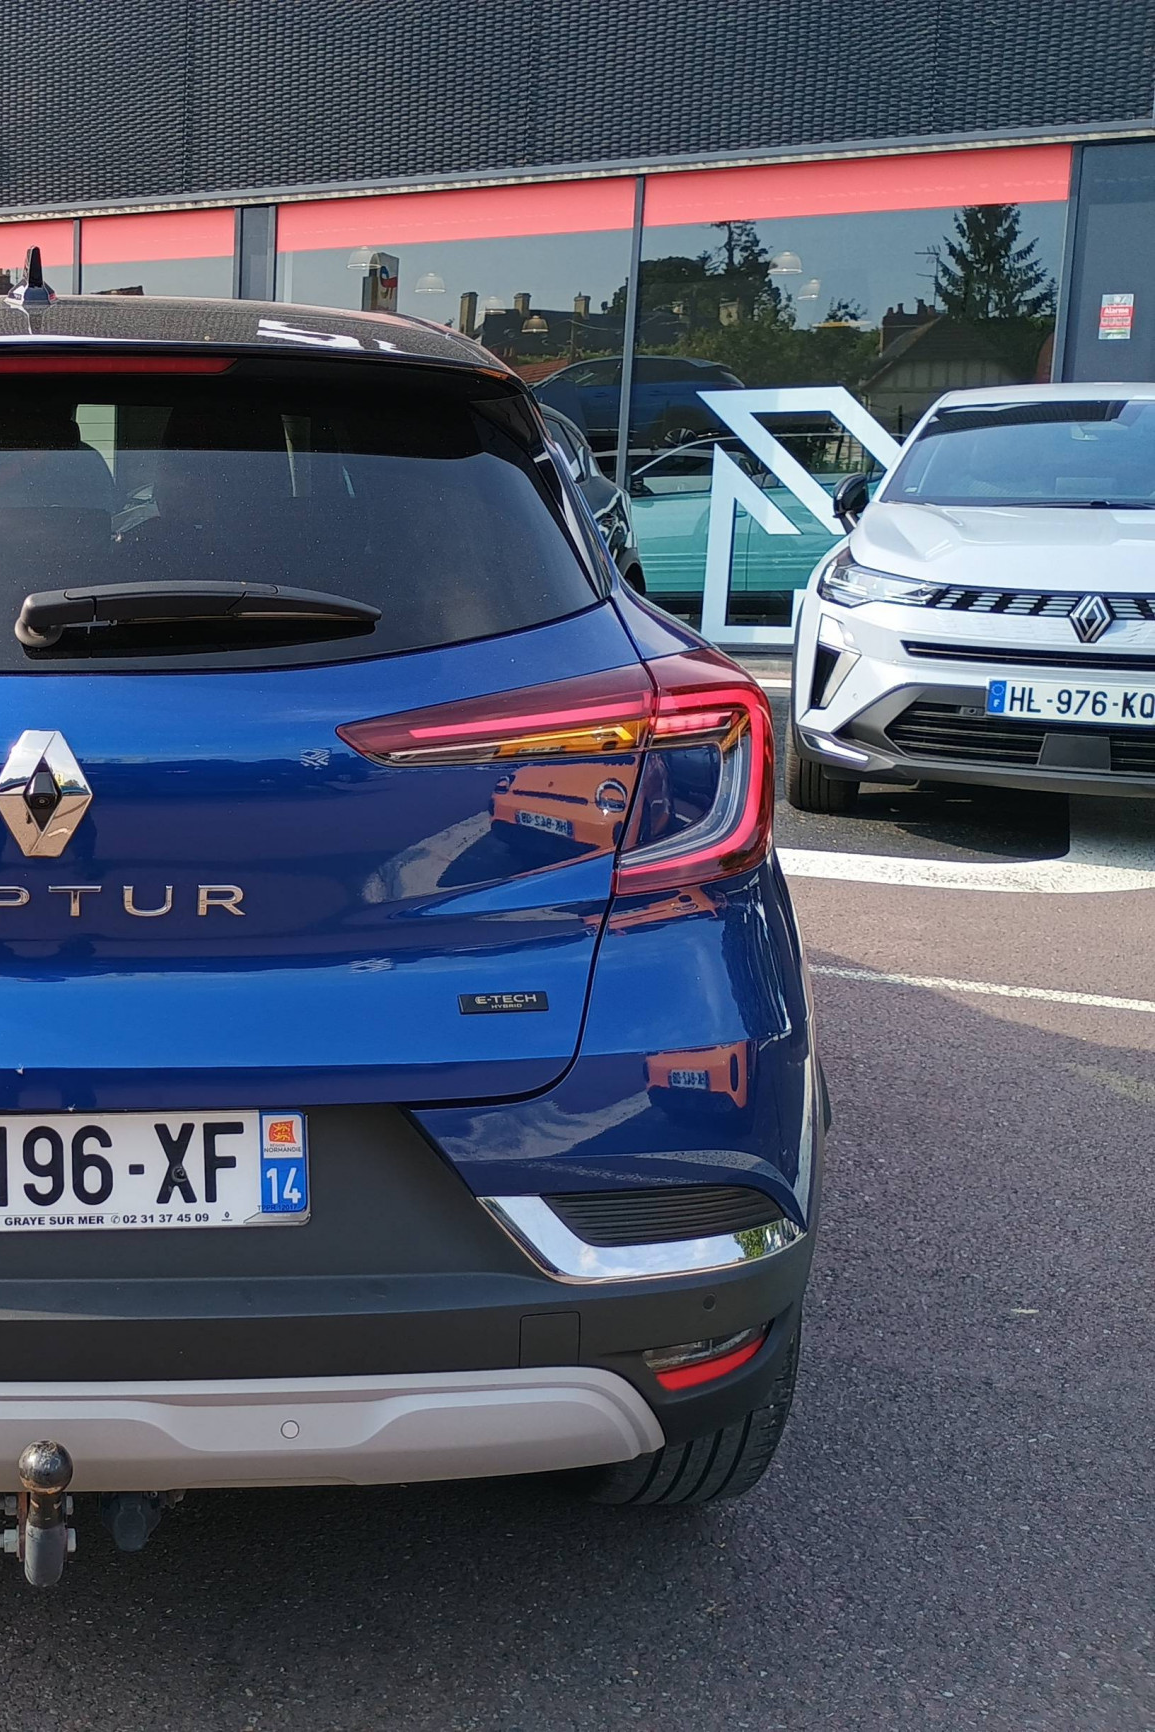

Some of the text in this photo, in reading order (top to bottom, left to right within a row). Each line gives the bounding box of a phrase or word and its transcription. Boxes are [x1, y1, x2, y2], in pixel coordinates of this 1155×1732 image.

[474, 994, 537, 1004] E-TECH
[266, 1167, 302, 1204] 14
[4, 1216, 45, 1226] GRAYE
[49, 1216, 76, 1225] SUR
[78, 1215, 104, 1225] MER
[122, 1214, 137, 1224] 02
[140, 1214, 154, 1223] 31
[158, 1214, 172, 1223] 37
[176, 1214, 191, 1223] 45
[194, 1213, 209, 1223] 09
